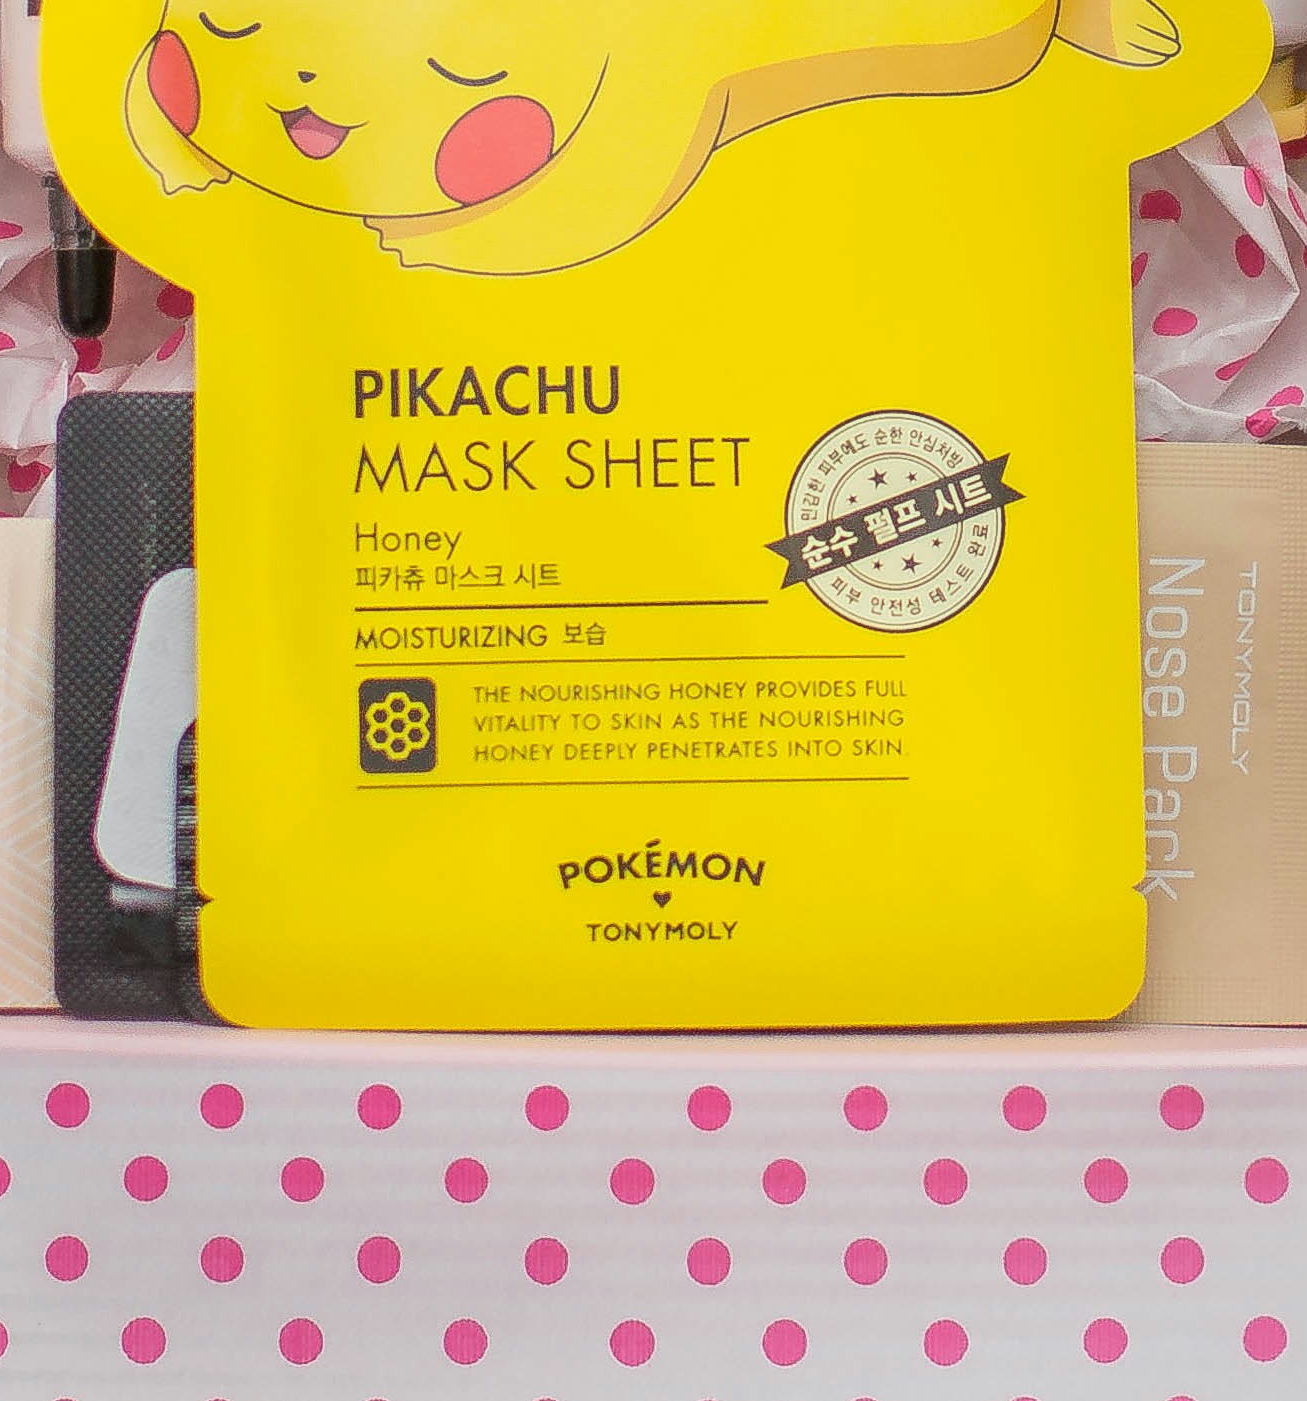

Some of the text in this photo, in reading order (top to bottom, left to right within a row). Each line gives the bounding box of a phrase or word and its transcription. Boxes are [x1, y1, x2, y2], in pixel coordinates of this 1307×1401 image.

[354, 365, 620, 418] PIKACHU
[354, 437, 751, 493] MASK SHEET
[801, 479, 826, 521] 민감한
[874, 427, 902, 445] 순한
[909, 429, 964, 469] 안심처방
[354, 523, 462, 559] Honey
[801, 474, 992, 570] 순수 펄프 시트
[355, 564, 561, 592] 피카츄 마스크 시트
[831, 523, 989, 617] 피부 안전성 테스트 완료
[354, 622, 606, 650] MOISTURIZING 보습
[473, 678, 908, 704] THE NOURISHING HONEY PROVIDES FULL
[1230, 561, 1259, 776] TONYMOLY
[473, 708, 905, 733] VITALITY TO SKIN AS THE NOURISHING
[1139, 557, 1206, 902] Nose Pack
[473, 743, 553, 763] HONEY
[563, 741, 638, 762] DEEPLY
[646, 740, 778, 760] PENETRATES
[788, 738, 844, 758] INTO
[559, 839, 766, 889] POKÉMON
[587, 921, 738, 942] TONYMOLY
